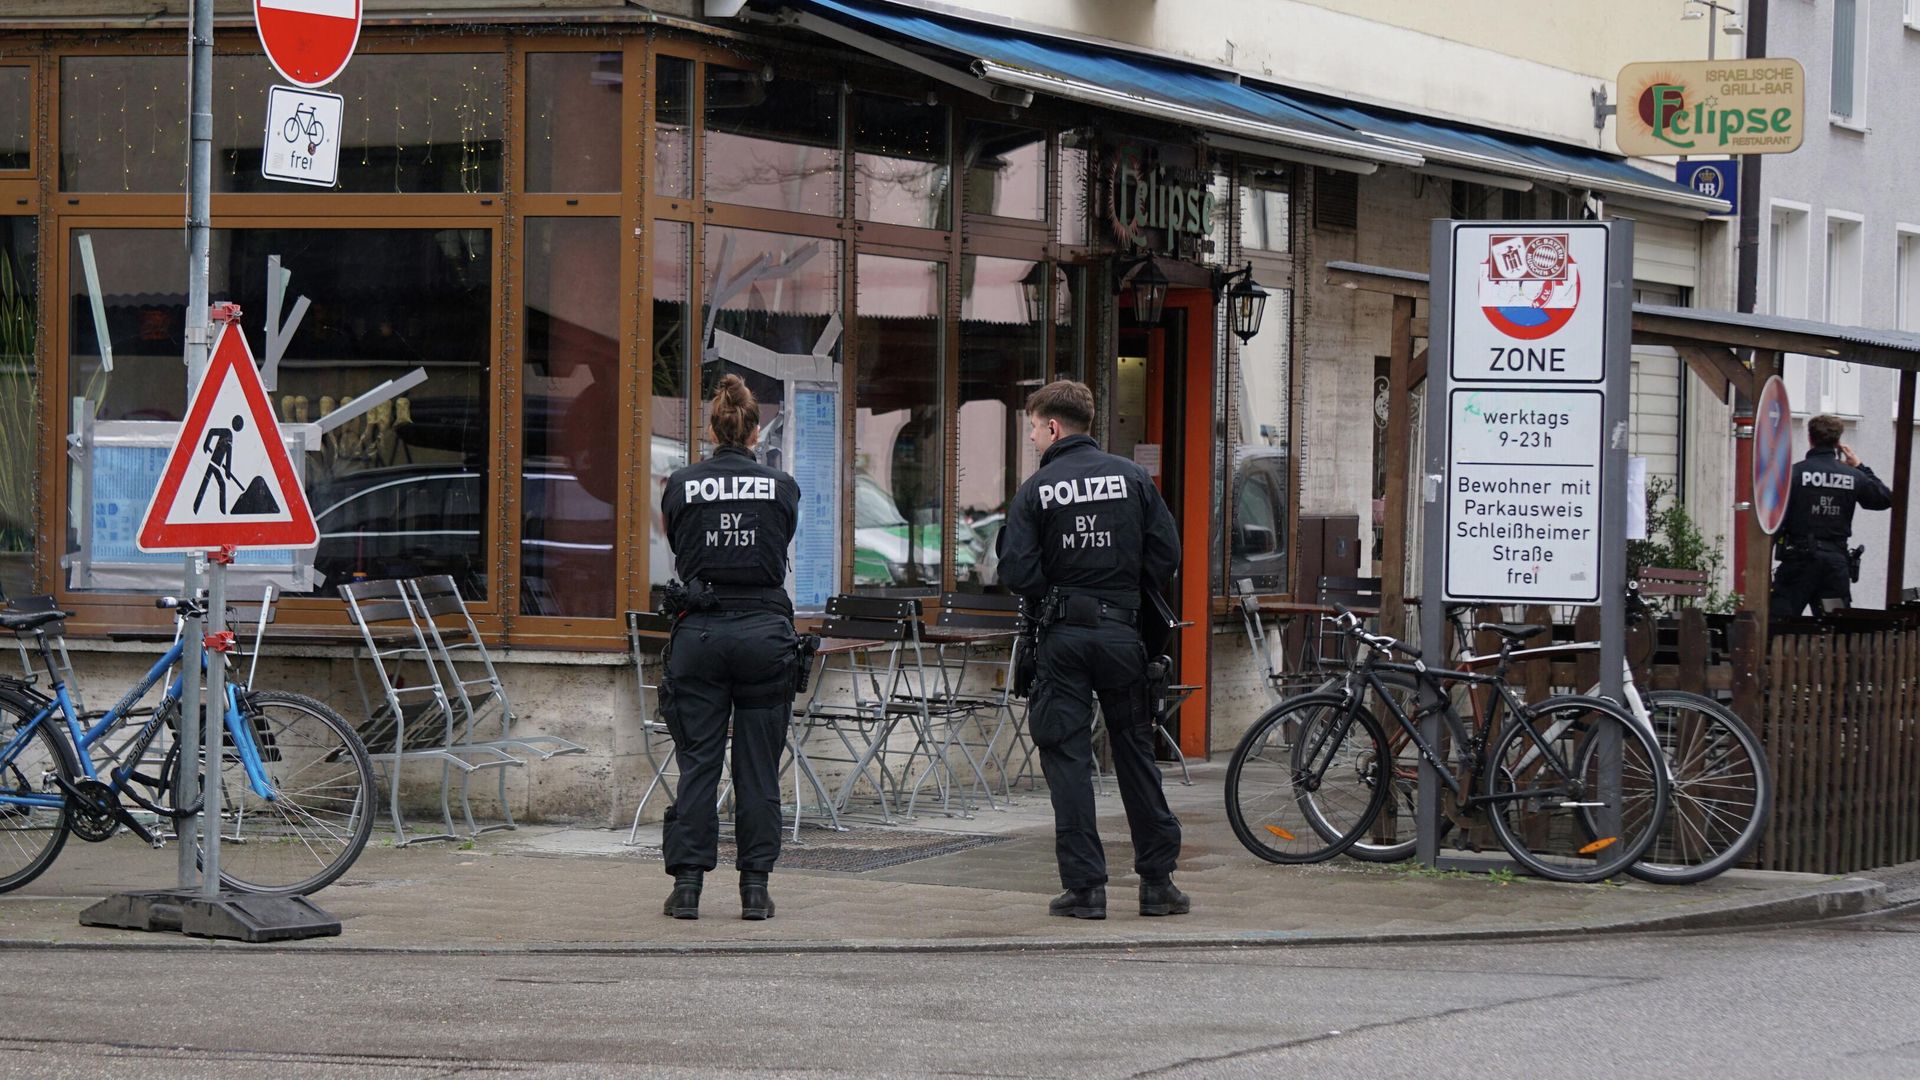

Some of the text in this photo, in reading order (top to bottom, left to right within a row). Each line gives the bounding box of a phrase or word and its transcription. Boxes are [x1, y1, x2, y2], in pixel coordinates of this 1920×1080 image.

[1706, 67, 1794, 82] ISRAELISCHE
[1720, 83, 1793, 97] GRILL-BAR
[1732, 136, 1792, 146] RESTAURANT
[290, 150, 313, 171] frei
[1489, 347, 1566, 372] ZONE
[1483, 409, 1569, 429] werktags
[685, 476, 776, 503] POLIZEI
[1458, 477, 1591, 495] Bewohner mit
[1801, 471, 1855, 490] POLIZEI
[1038, 475, 1128, 510] POLIZEI
[1820, 496, 1834, 506] BY
[1464, 499, 1583, 518] Parkausweis
[1811, 505, 1840, 516] M 7131
[720, 513, 742, 530] BY
[1075, 515, 1097, 532] BY
[706, 530, 756, 547] M 7131
[1062, 531, 1112, 549] M 7131
[1456, 522, 1591, 540] Schleißheimer
[1492, 545, 1553, 562] Straße
[1507, 567, 1538, 585] frei
